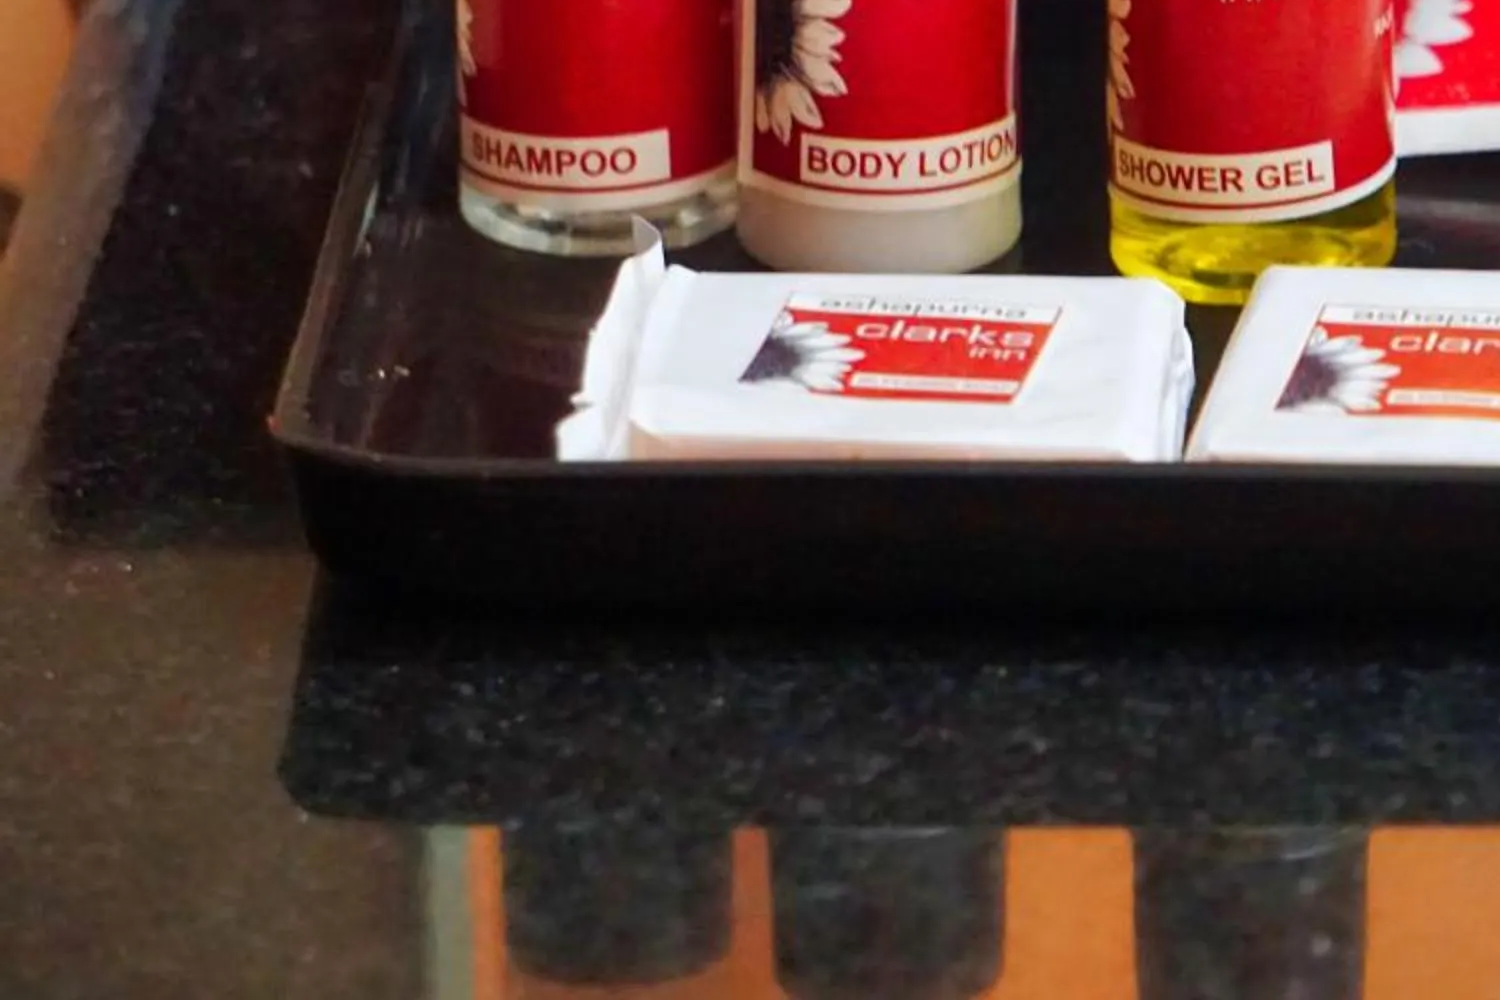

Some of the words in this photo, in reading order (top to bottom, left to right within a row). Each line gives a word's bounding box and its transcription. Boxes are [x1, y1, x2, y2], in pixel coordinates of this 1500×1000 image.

[472, 131, 637, 177] SHAMPOO
[807, 145, 905, 178] BODY
[919, 128, 1015, 177] LOTION
[1117, 150, 1244, 193] SHOWER
[1255, 159, 1325, 191] GEL
[856, 320, 1035, 349] clarks
[969, 347, 1026, 362] inn
